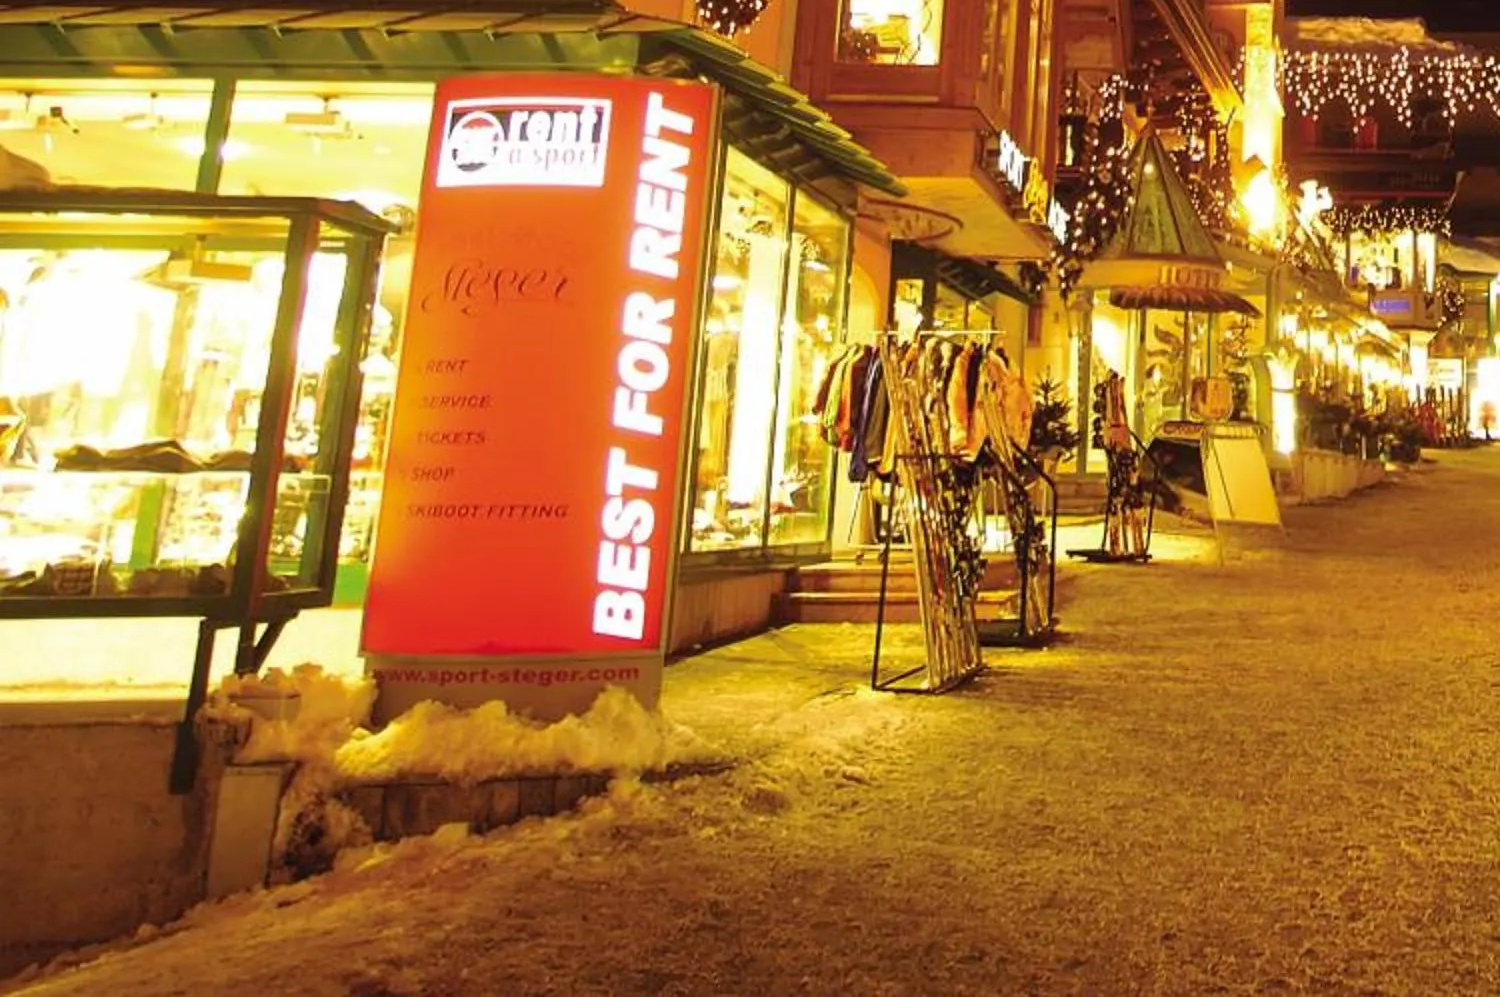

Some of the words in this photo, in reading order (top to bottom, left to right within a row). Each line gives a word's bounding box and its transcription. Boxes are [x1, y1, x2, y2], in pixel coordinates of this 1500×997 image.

[508, 105, 598, 143] rent
[533, 145, 599, 171] sport
[629, 91, 695, 280] RENT
[424, 359, 469, 374] RENT
[612, 290, 676, 436] FOR
[420, 395, 492, 409] SERVICE
[416, 431, 487, 445] TICKETS
[410, 467, 455, 482] SHOP
[406, 505, 480, 519] SKIBOOT
[486, 505, 570, 519] FITTING
[591, 446, 659, 640] BEST
[374, 666, 640, 687] www.sport-steger.com
